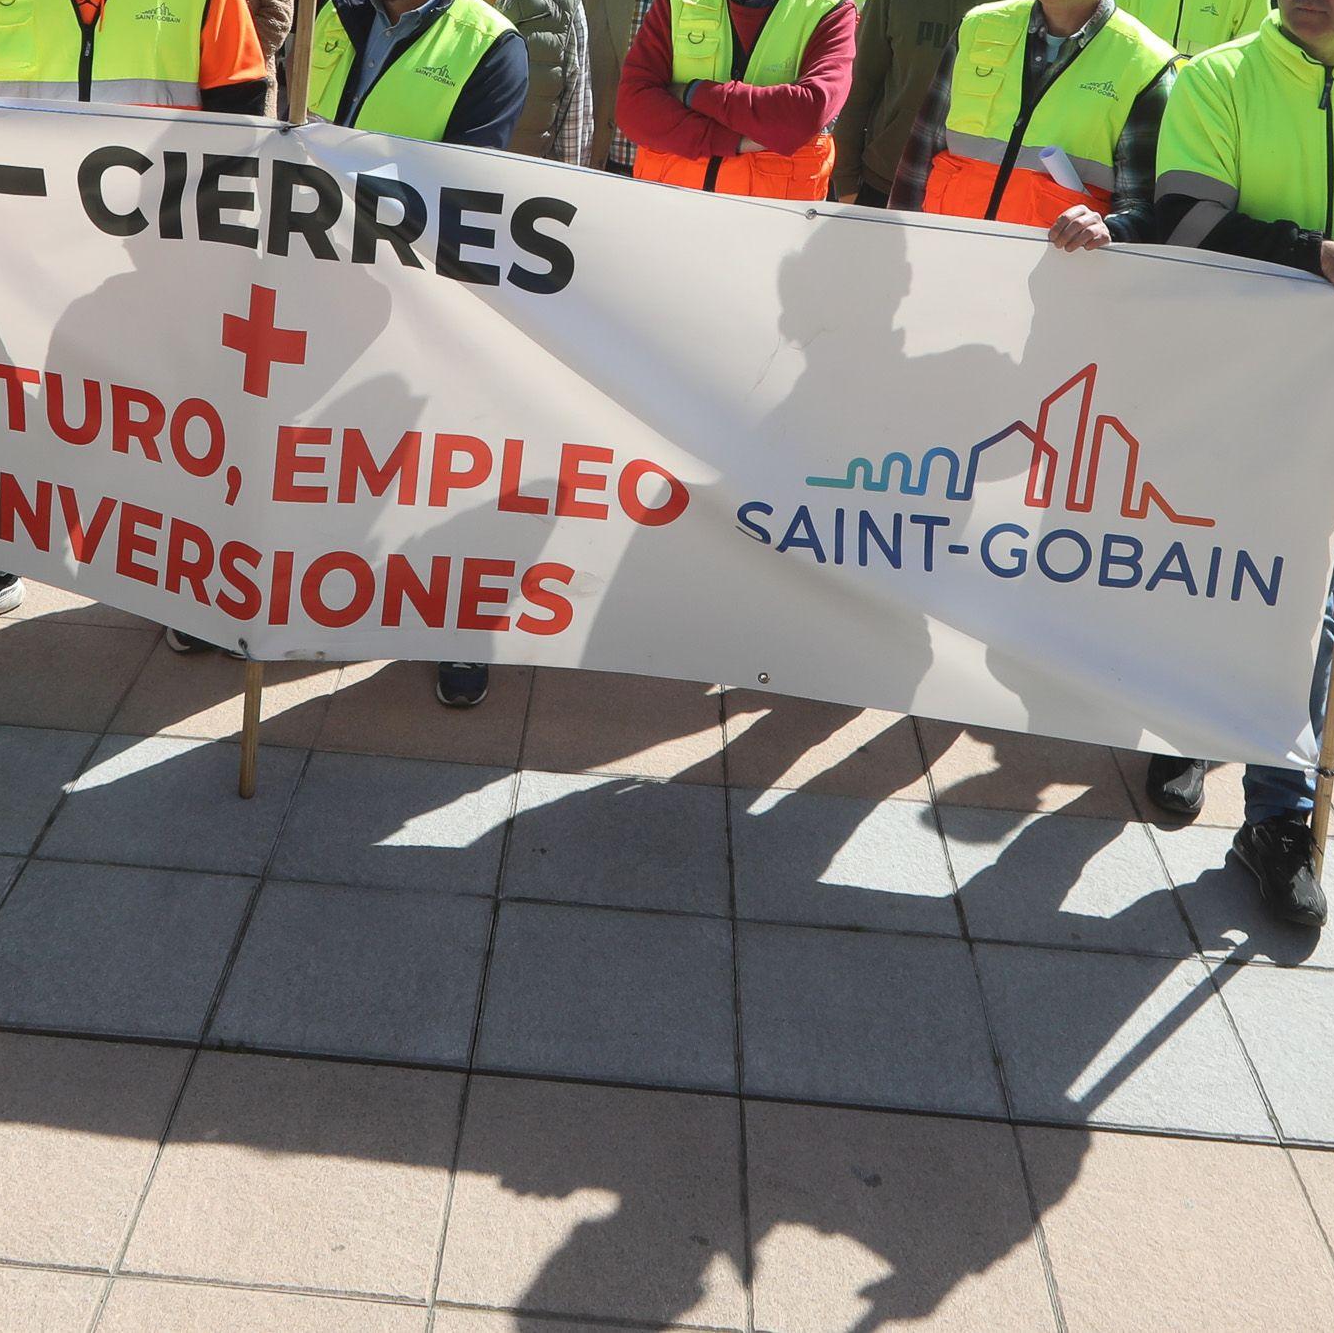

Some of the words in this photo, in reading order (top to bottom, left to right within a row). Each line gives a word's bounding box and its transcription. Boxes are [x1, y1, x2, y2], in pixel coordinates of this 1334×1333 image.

[135, 13, 181, 24] SAINT-GOBAIN
[415, 67, 456, 88] SAINT-GOBAIN
[77, 145, 578, 295] CIERRES
[272, 425, 690, 527] EMPLEO
[735, 500, 1284, 606] SAINT-GOBAIN
